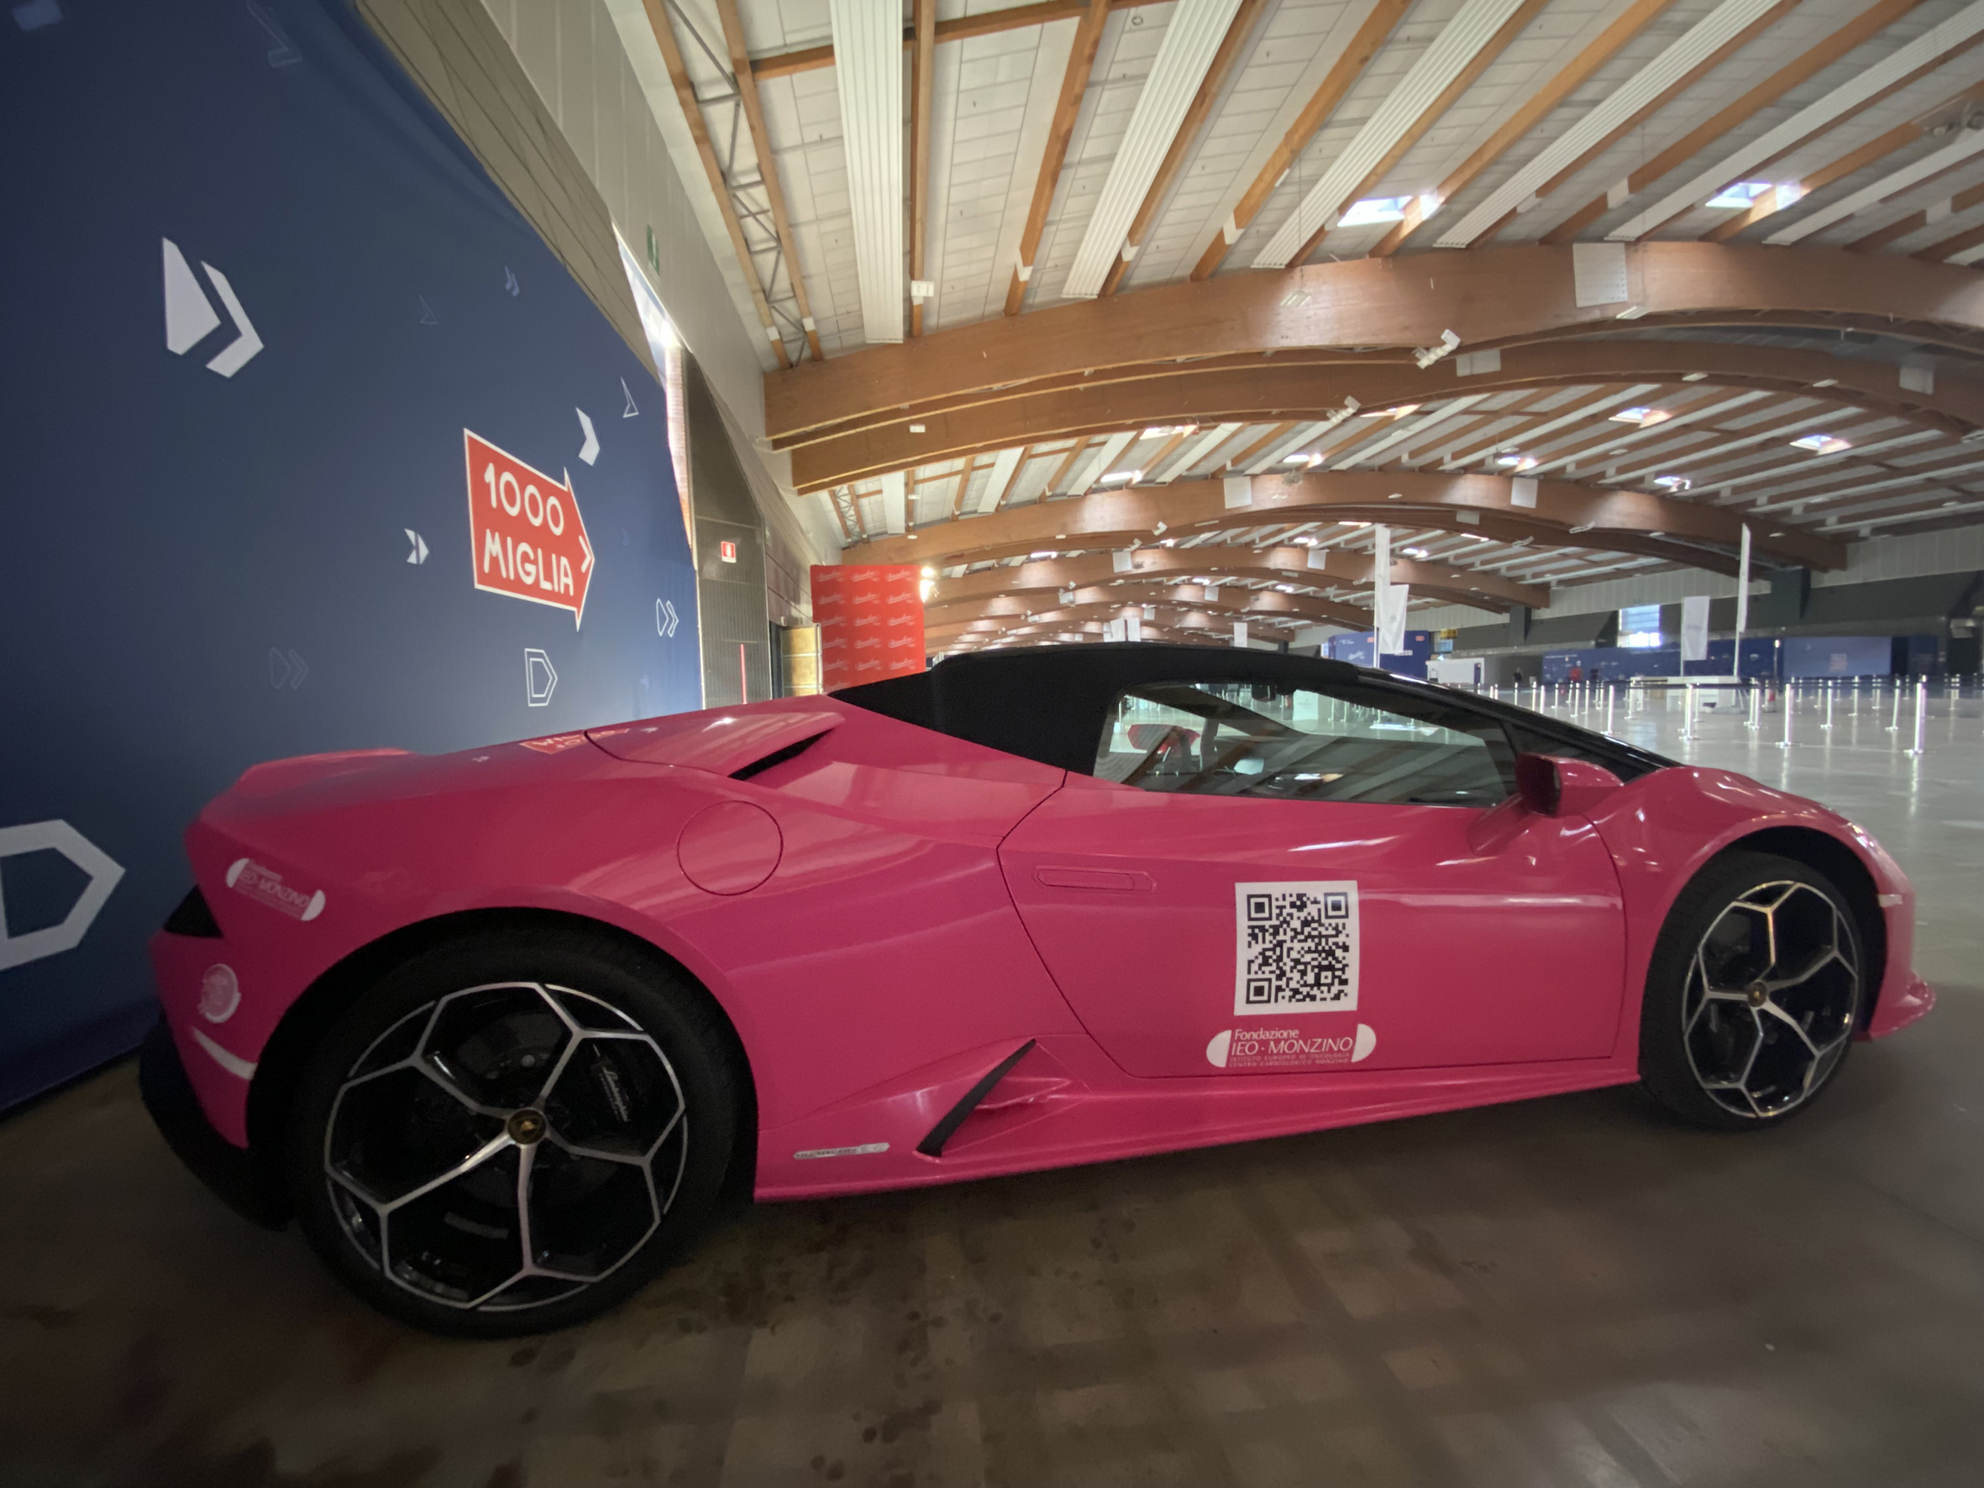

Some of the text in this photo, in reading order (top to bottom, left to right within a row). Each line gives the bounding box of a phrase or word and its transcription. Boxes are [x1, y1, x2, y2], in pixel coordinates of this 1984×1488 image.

[484, 462, 564, 536] 1000
[483, 528, 574, 597] MIGLIA
[1231, 1037, 1353, 1056] IEO MONZINO
[1234, 1028, 1299, 1041] Fondazione
